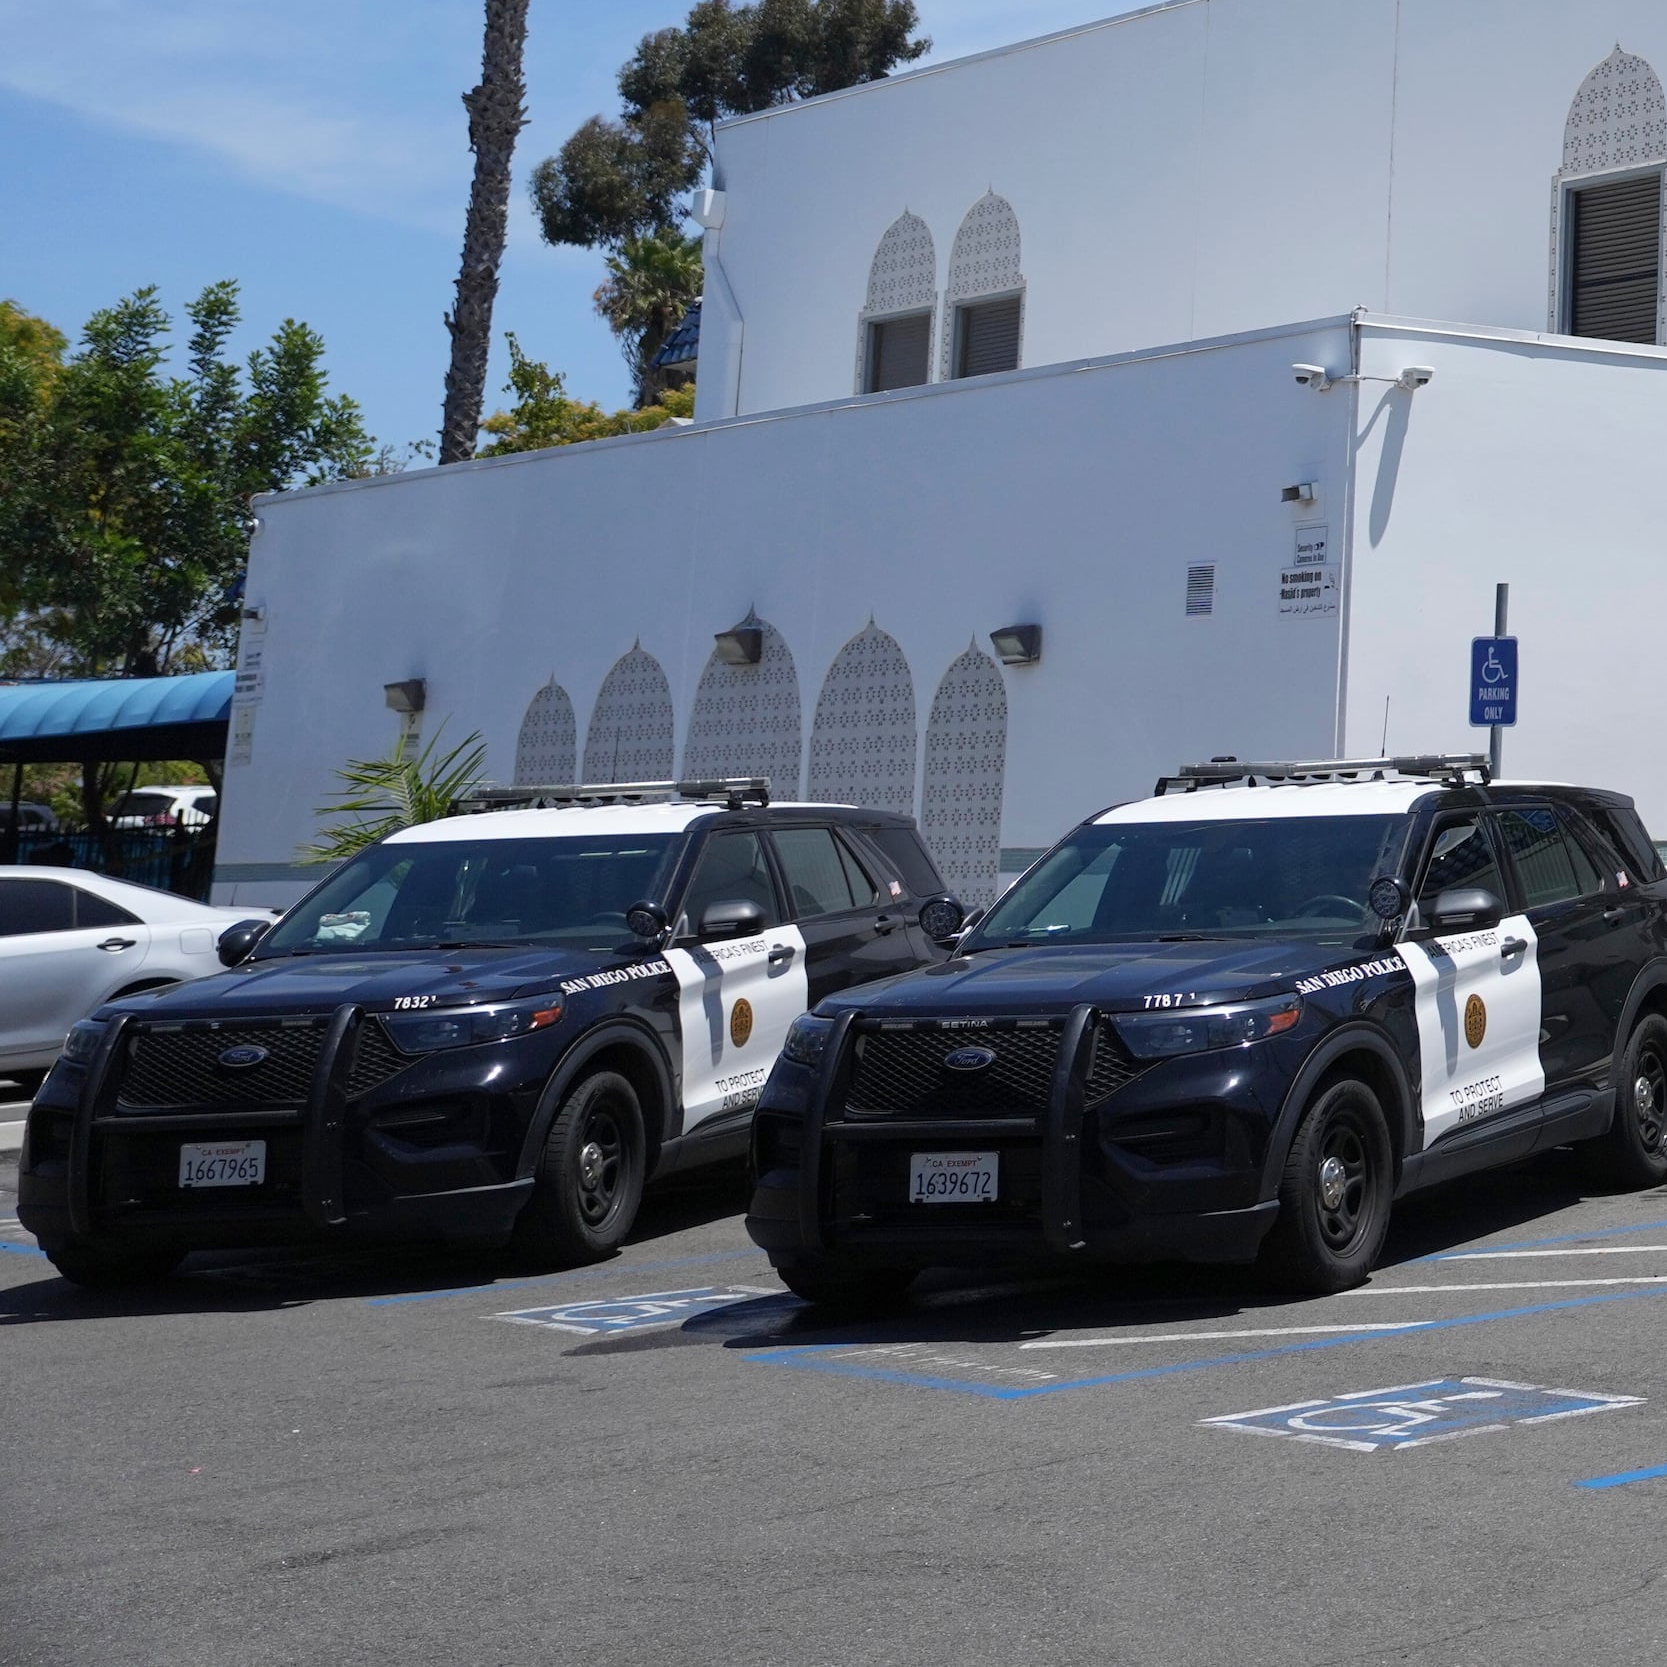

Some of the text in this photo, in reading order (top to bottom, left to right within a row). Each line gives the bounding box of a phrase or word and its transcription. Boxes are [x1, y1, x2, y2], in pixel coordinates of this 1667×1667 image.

[1478, 687, 1510, 701] PARKING
[1484, 706, 1503, 720] ONLY
[740, 940, 769, 954] FINEST
[1470, 932, 1500, 950] FINEST
[560, 960, 672, 996] SAN DIEGO POLICE
[1295, 956, 1407, 995] SAN DIEGO POLICE
[394, 996, 428, 1009] 7832
[942, 1020, 989, 1029] SETINA
[715, 1068, 768, 1093] TO PROTECT
[1449, 1075, 1503, 1106] TO PROTECT
[722, 1085, 764, 1109] AND SERV
[1458, 1092, 1504, 1123] AND SERVE
[184, 1157, 259, 1182] 1667965
[932, 1159, 977, 1168] CA EXEMPT
[915, 1172, 991, 1196] 1639672
